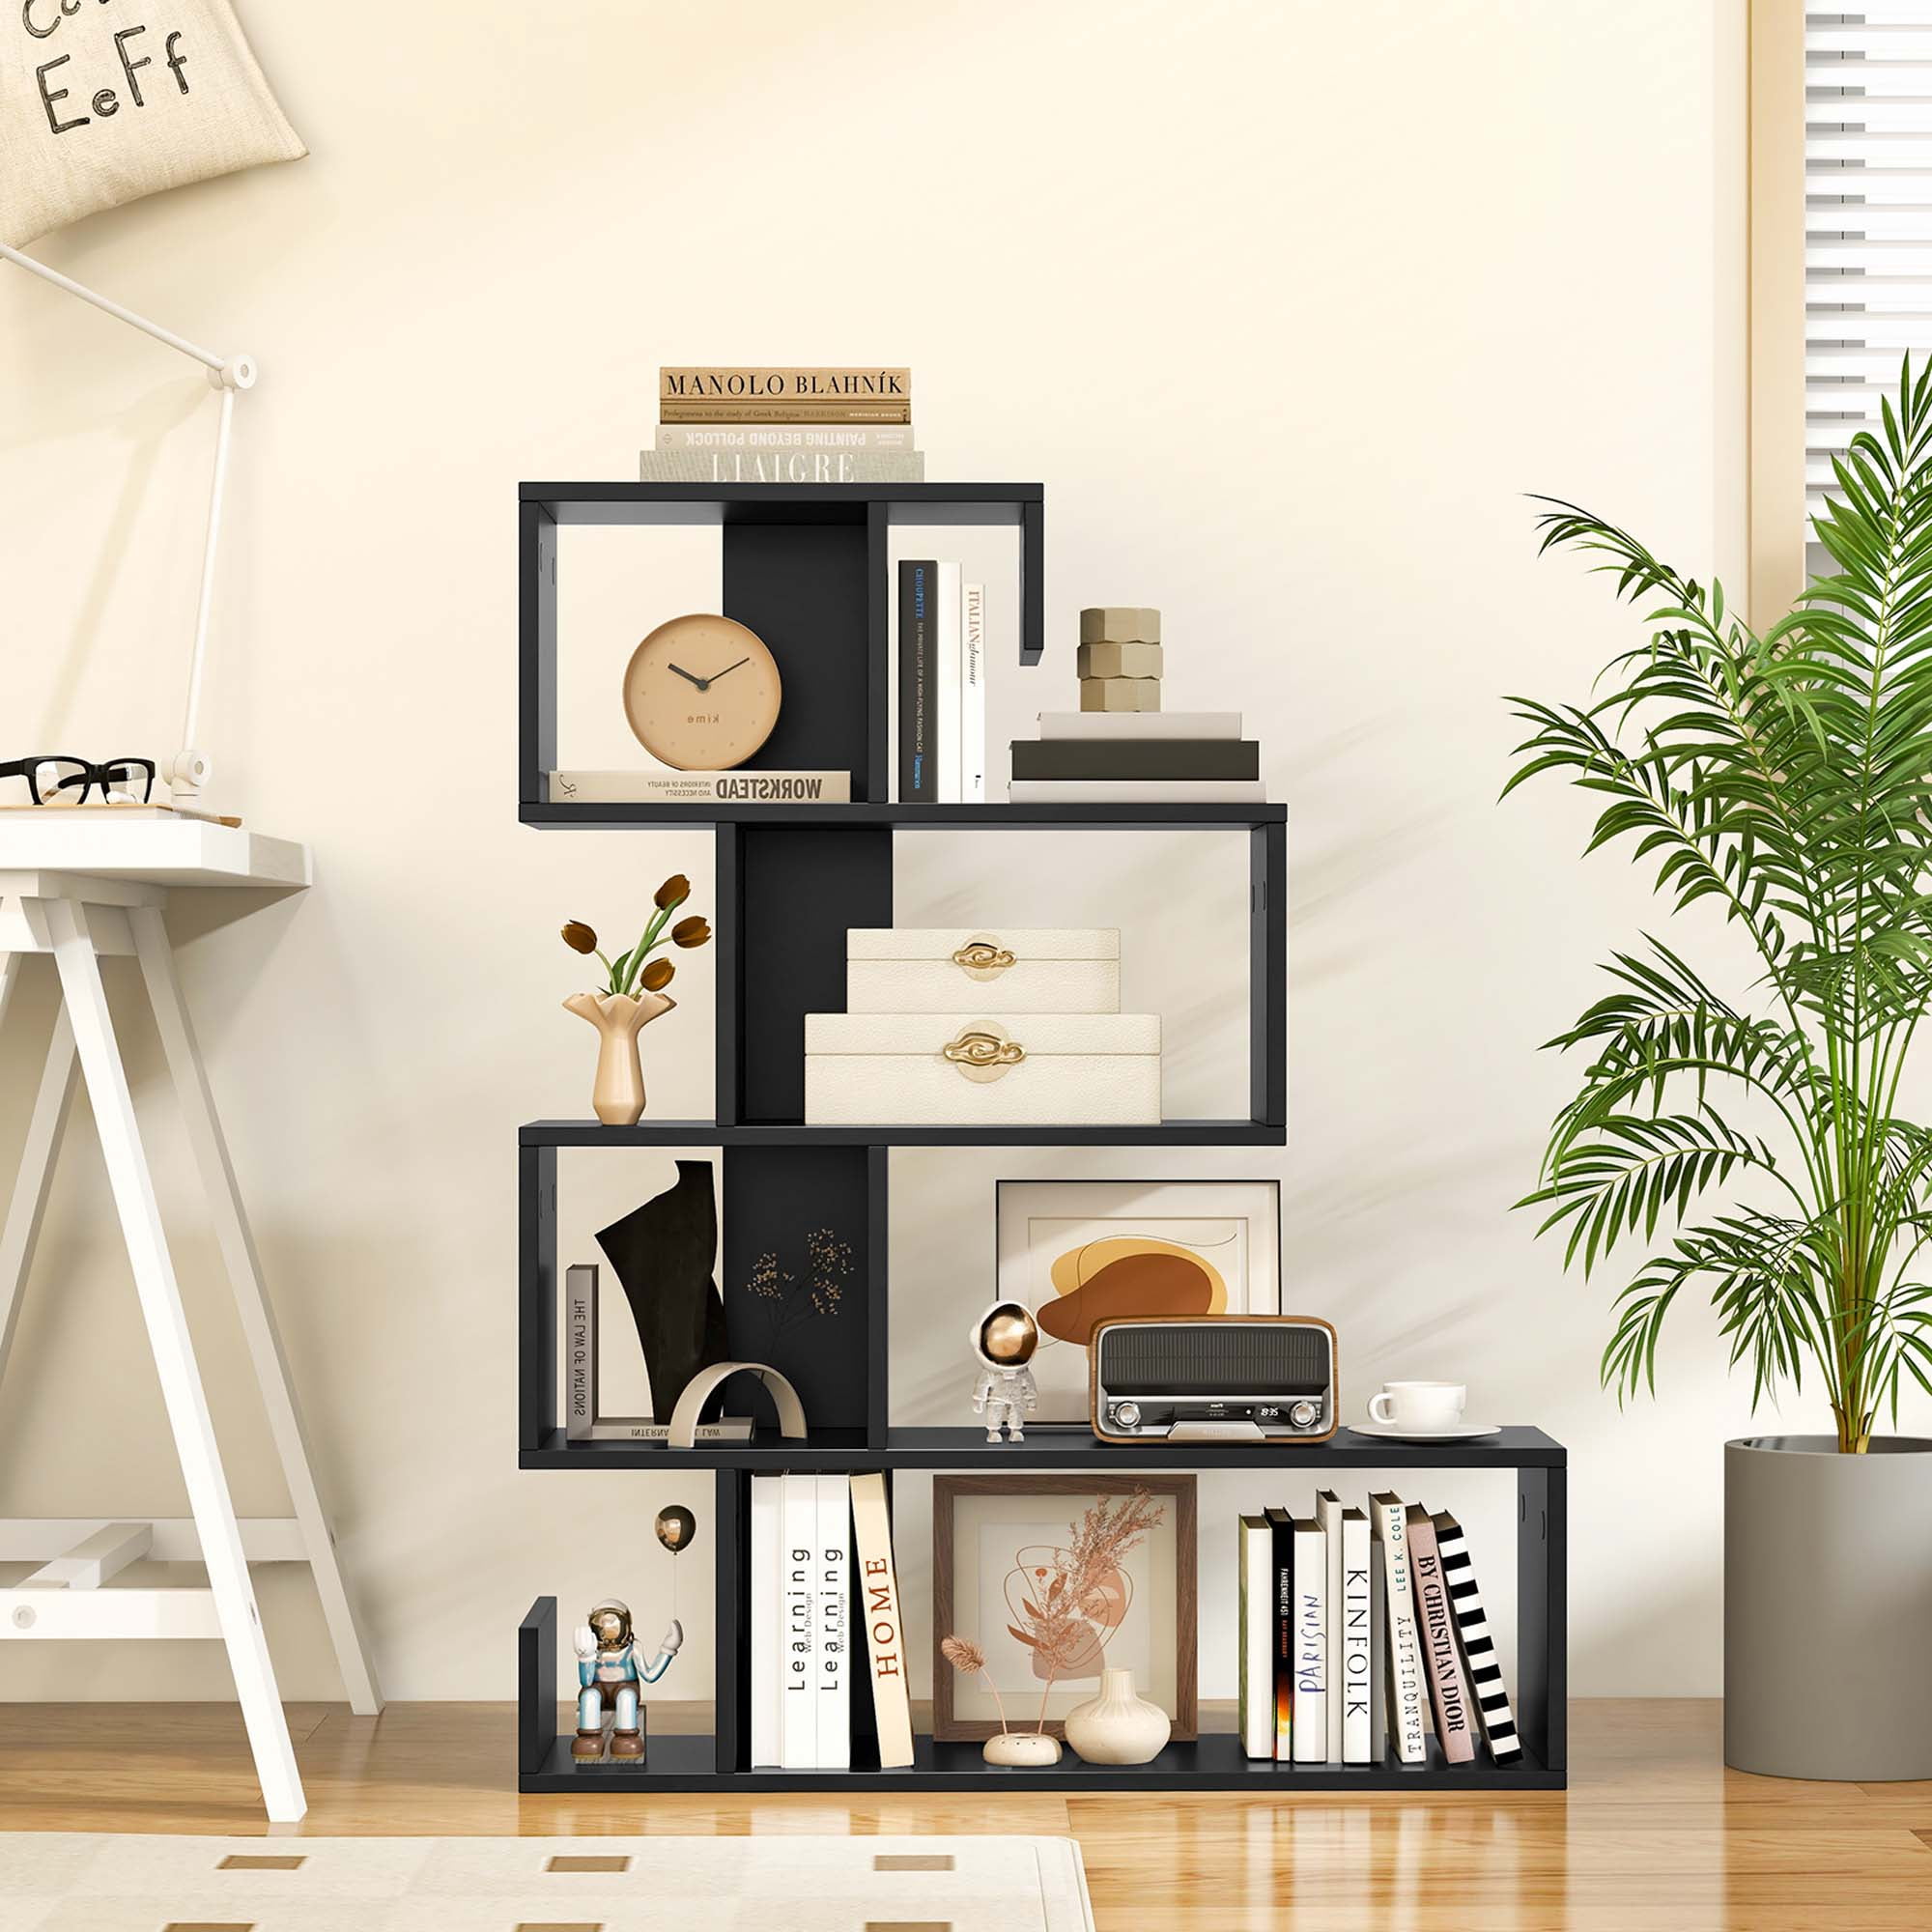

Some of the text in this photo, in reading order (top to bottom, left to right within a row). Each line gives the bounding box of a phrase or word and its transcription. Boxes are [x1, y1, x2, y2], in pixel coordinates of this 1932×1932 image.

[667, 371, 903, 395] MANOLO BLAHNÍK
[686, 432, 745, 445] POLLOCK
[713, 453, 855, 482] LIAIGRE
[750, 432, 802, 445] BEYOND
[806, 432, 866, 445] PAINTING
[915, 568, 924, 619] CHOUPETTE
[1390, 1507, 1406, 1592] LEE K. COLE
[787, 1549, 810, 1690] Learning
[804, 1592, 813, 1654] Web Design
[820, 1549, 843, 1690] Learning
[837, 1592, 846, 1654] Web Design
[866, 1558, 899, 1679] HOME
[1347, 1570, 1368, 1718] KINFOLK
[1417, 1554, 1465, 1733] BY CHRISTIAN DIOR
[1397, 1617, 1422, 1753] TRANQUILITY
